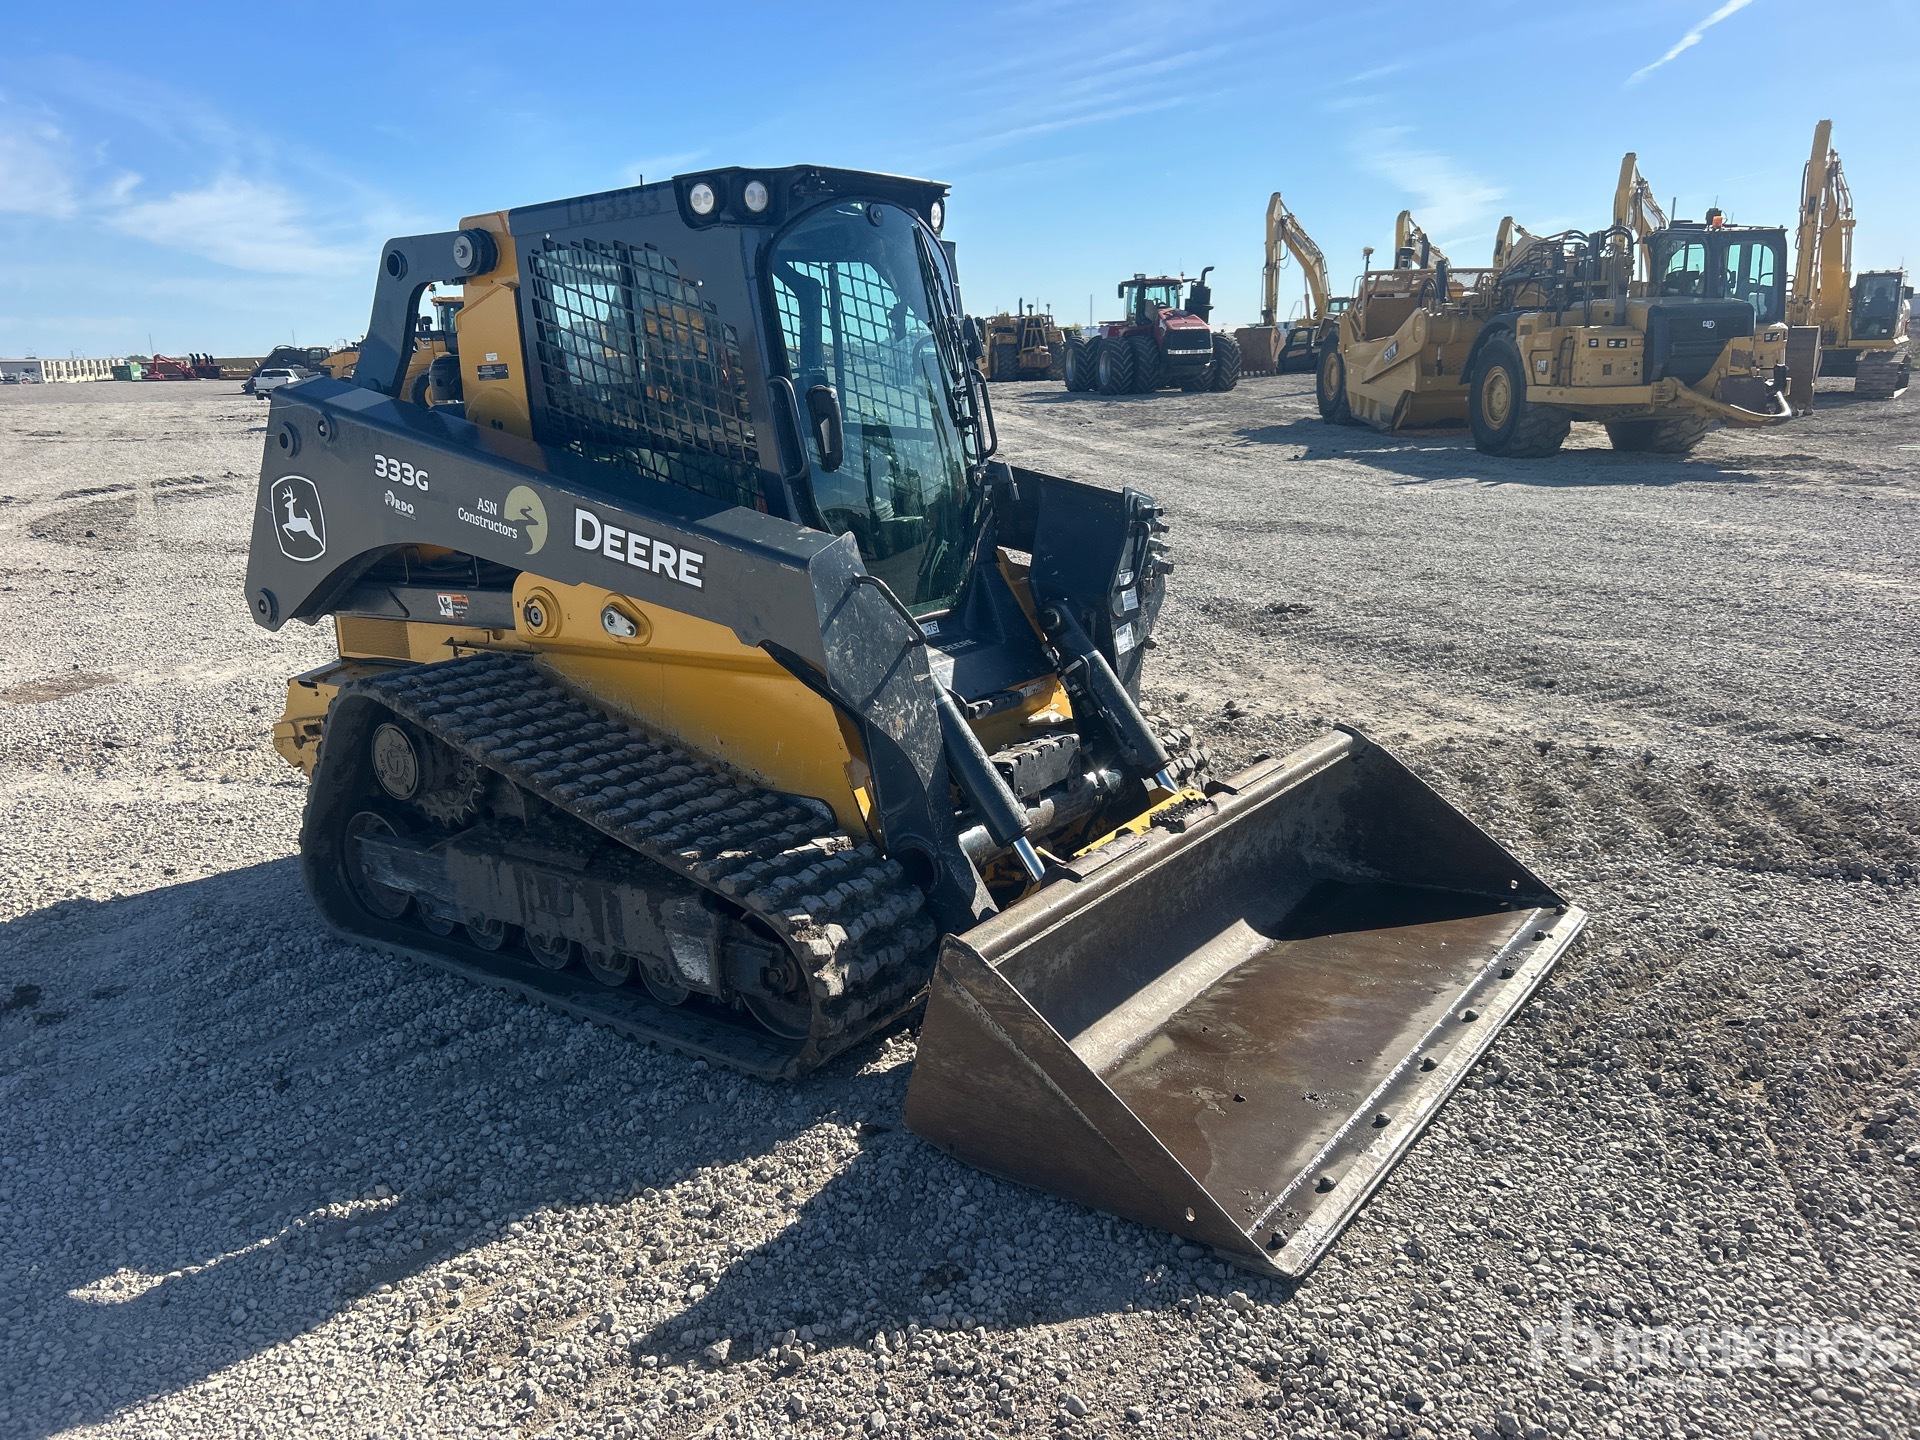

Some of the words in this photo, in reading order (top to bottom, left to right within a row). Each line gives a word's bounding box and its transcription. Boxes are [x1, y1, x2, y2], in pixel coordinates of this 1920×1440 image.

[374, 454, 429, 491] 333G
[458, 507, 518, 539] Constructors
[477, 498, 498, 515] ASN
[575, 508, 703, 587] DEERE
